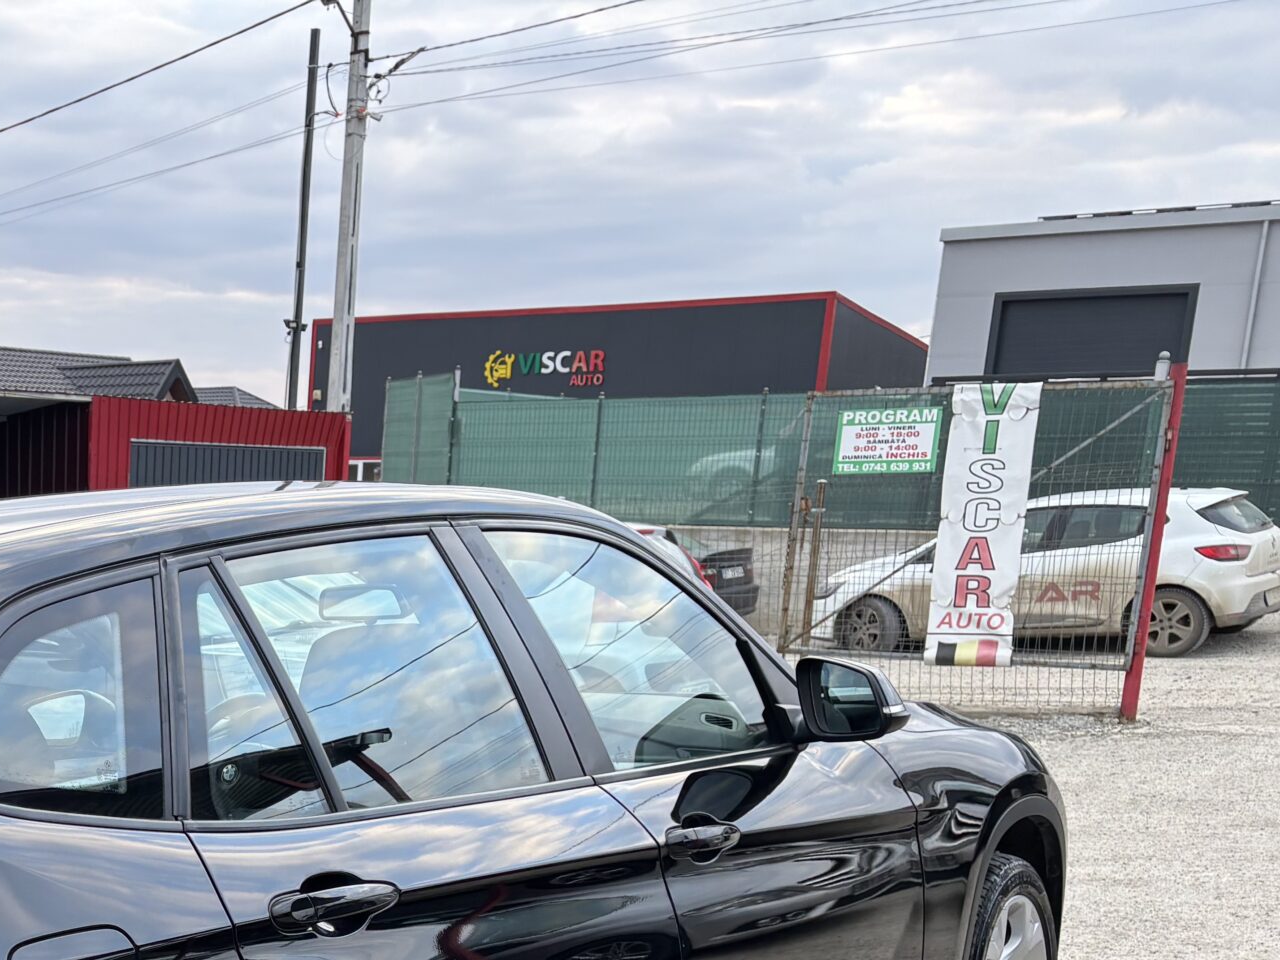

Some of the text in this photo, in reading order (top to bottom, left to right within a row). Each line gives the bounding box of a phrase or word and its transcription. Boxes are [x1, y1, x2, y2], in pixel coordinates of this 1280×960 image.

[518, 350, 605, 375] VISCAR
[569, 373, 604, 386] AUTO
[843, 409, 938, 424] PROGRAM
[837, 462, 931, 472] TEL: 0743 639 931
[953, 383, 1017, 609] VISCAR
[937, 612, 1005, 631] AUTO
